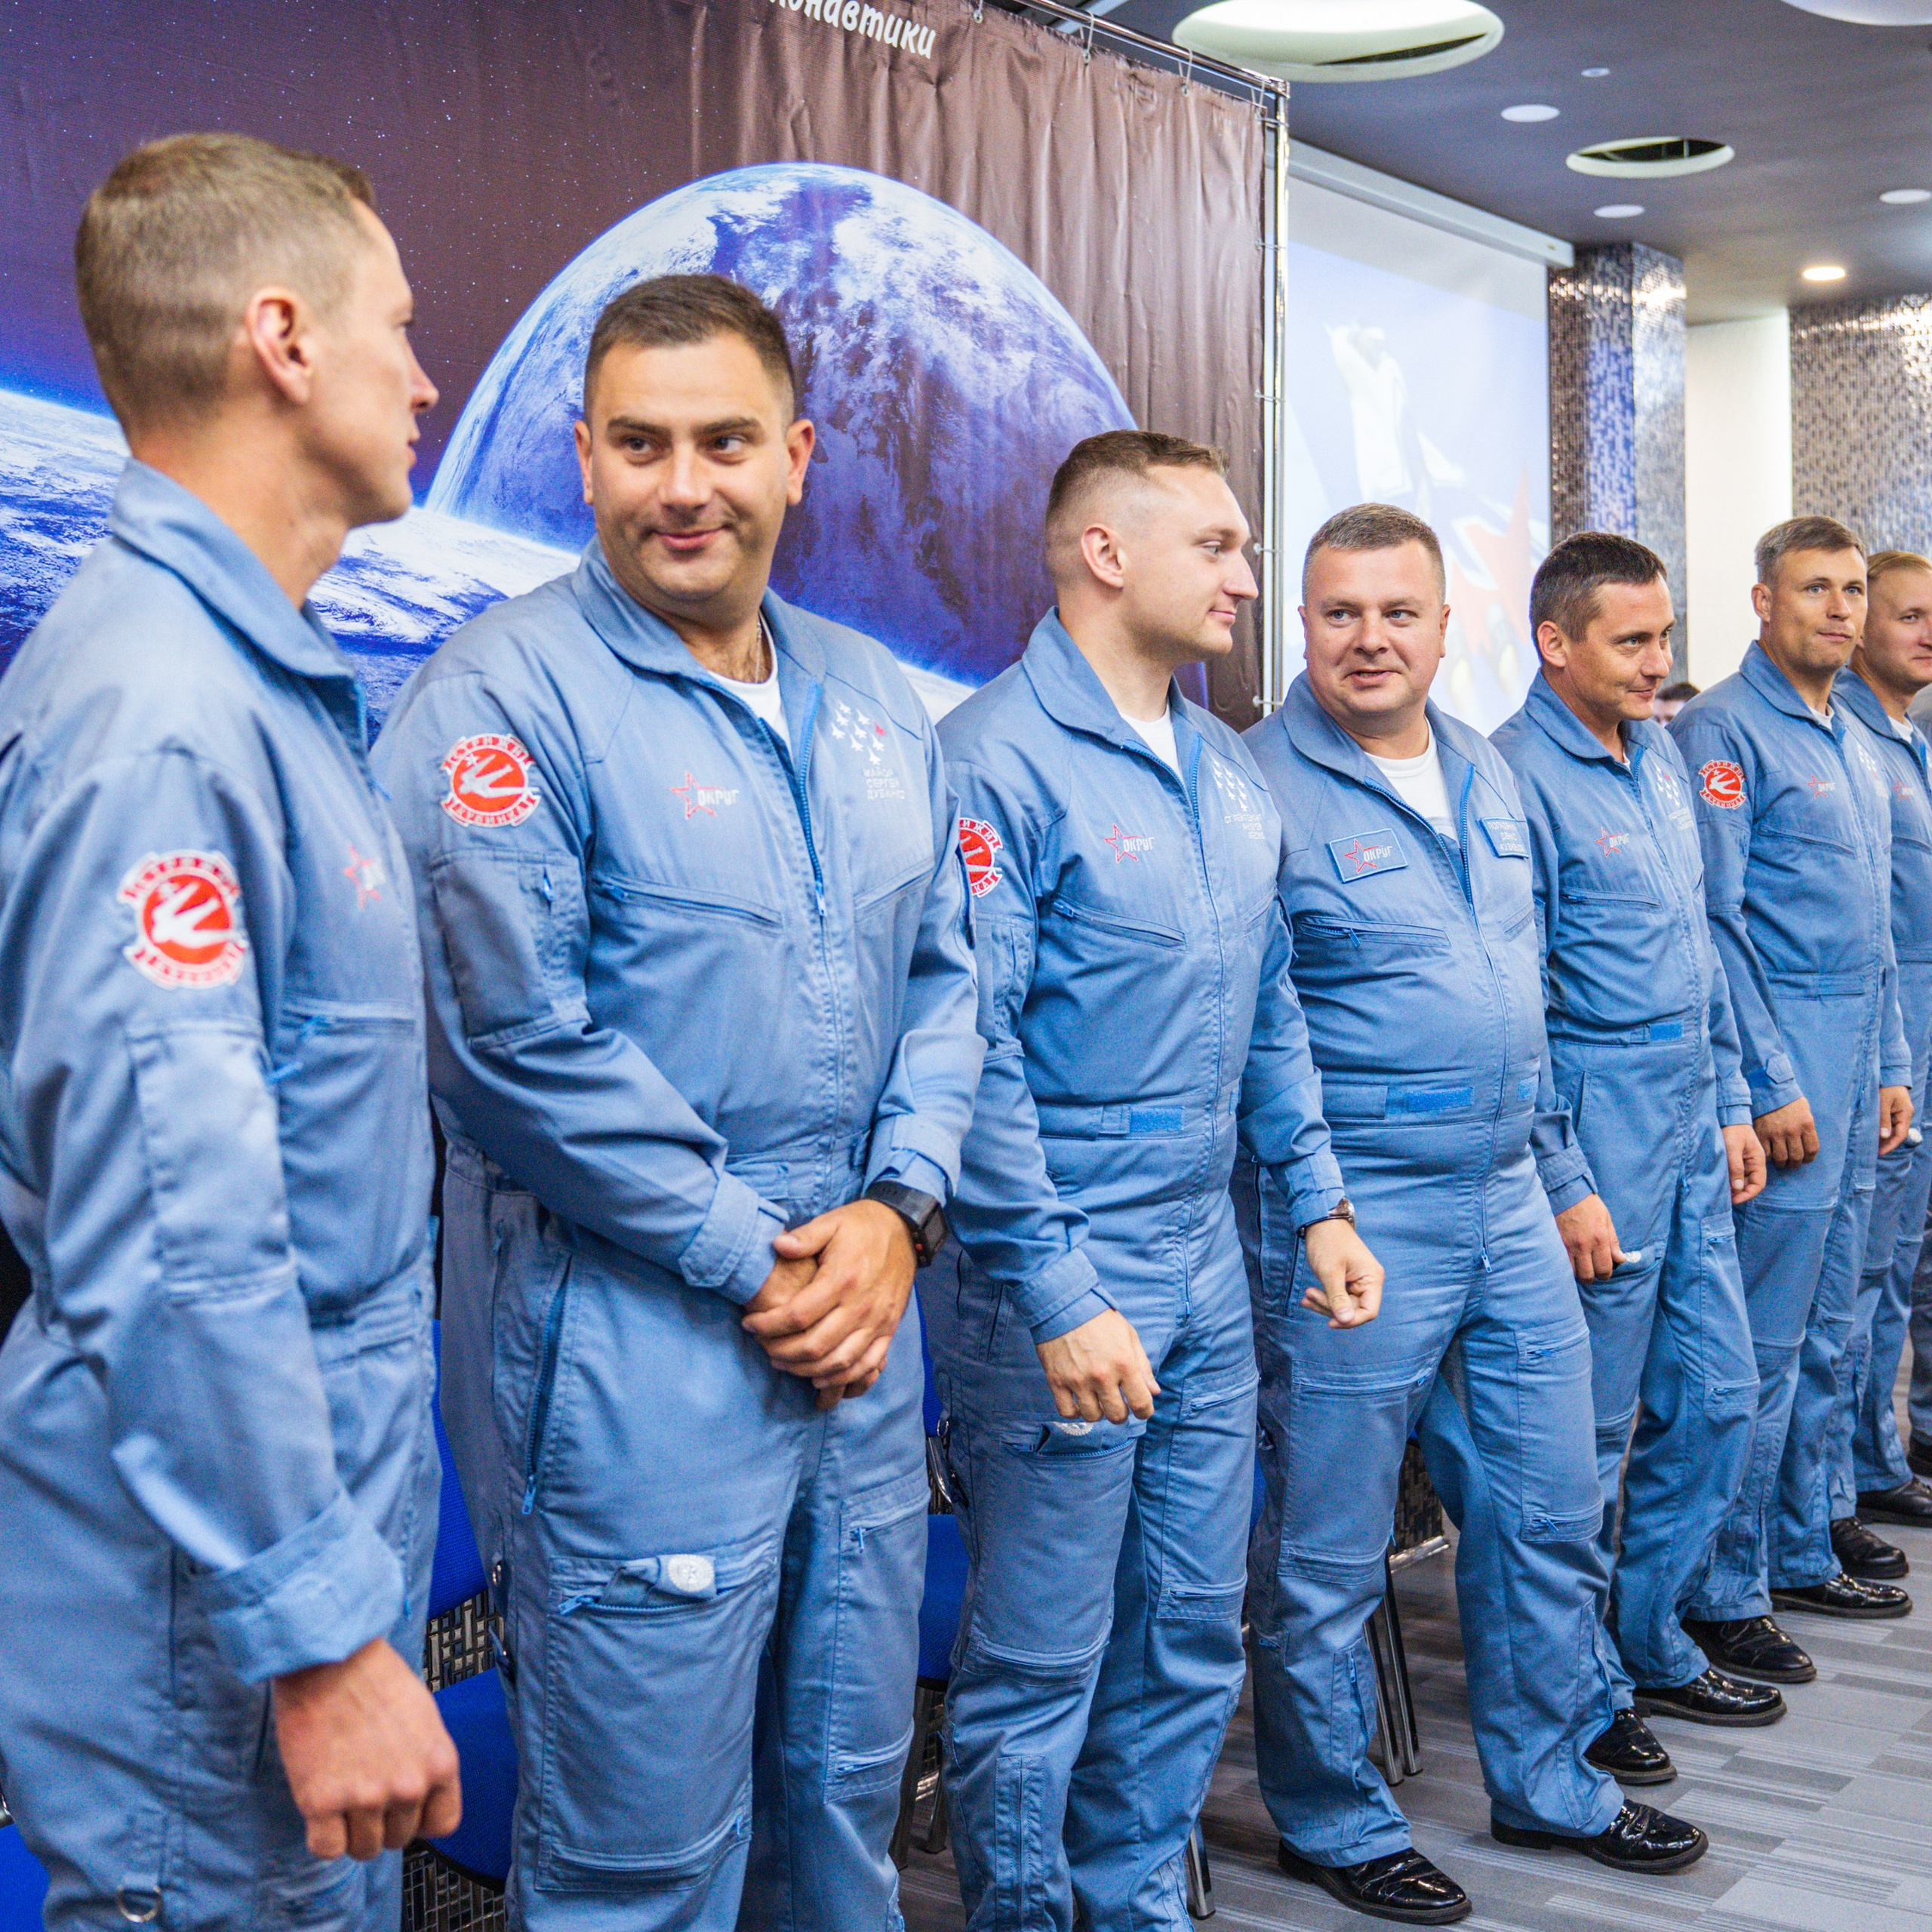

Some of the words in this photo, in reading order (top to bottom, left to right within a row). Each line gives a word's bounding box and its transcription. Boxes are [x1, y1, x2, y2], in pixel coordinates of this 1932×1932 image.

[770, 0, 937, 59] навтики
[697, 789, 739, 806] ОКРУГ
[1122, 837, 1155, 852] ОКРУГ
[1363, 846, 1393, 862] ОКРУГ
